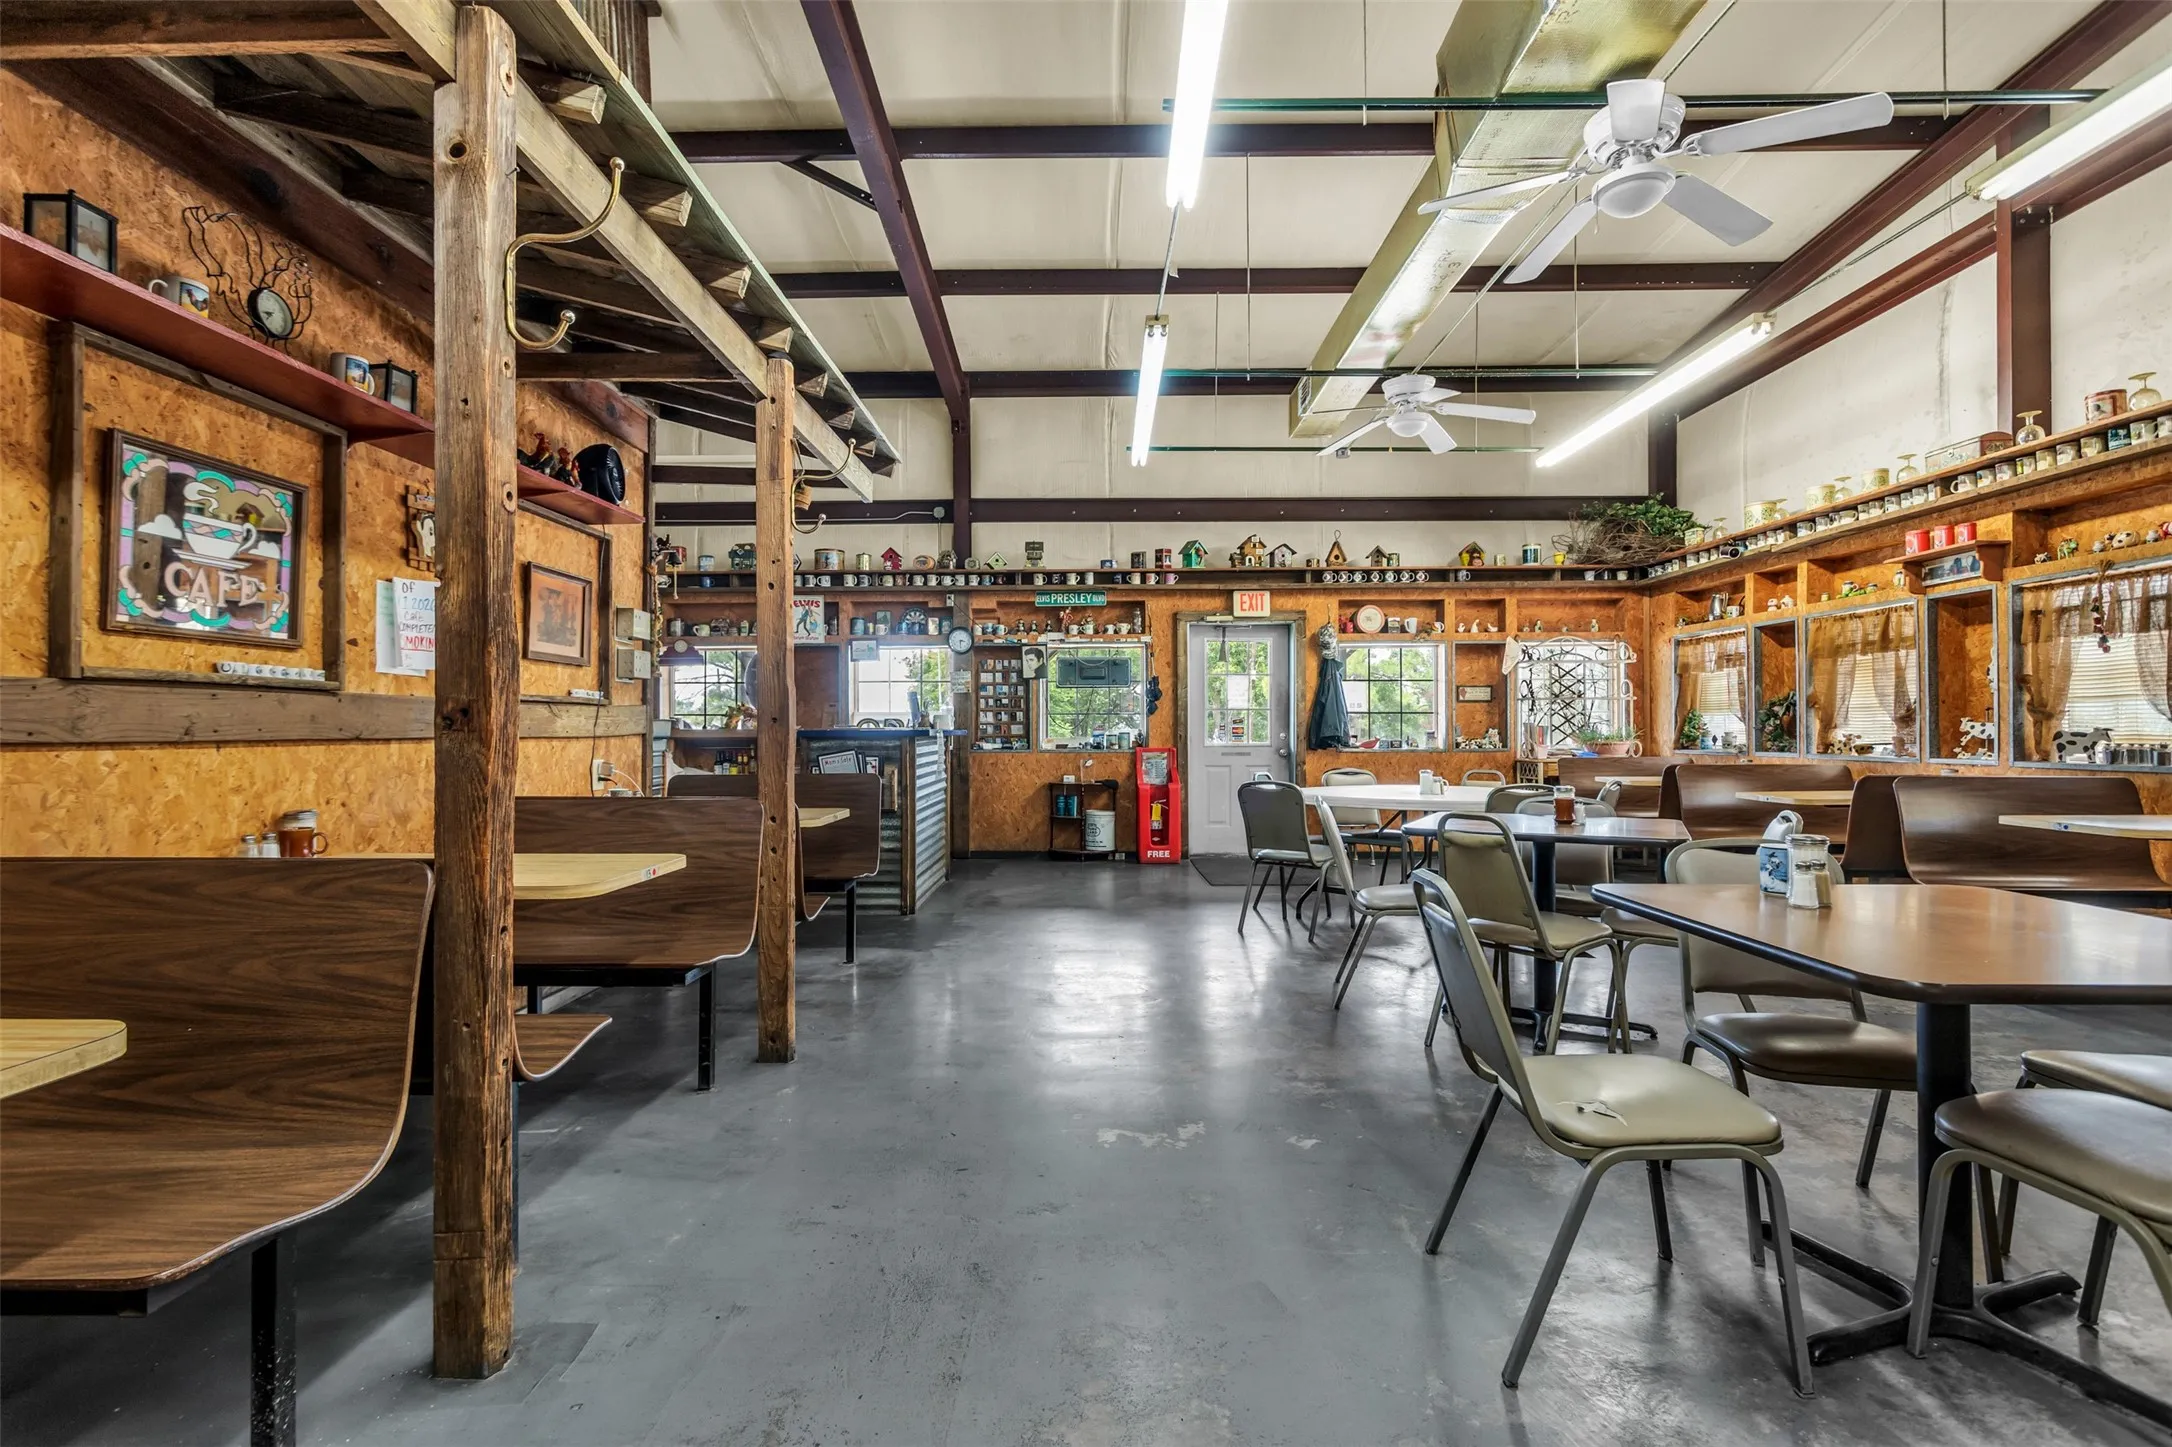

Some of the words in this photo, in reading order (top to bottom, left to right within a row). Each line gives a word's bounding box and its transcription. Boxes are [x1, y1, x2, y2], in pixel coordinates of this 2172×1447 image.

[164, 561, 262, 607] CAFE
[1051, 593, 1092, 603] PRESLEY
[1240, 593, 1265, 611] EXIT
[793, 600, 820, 608] ELVIS
[1147, 850, 1170, 858] FREE
